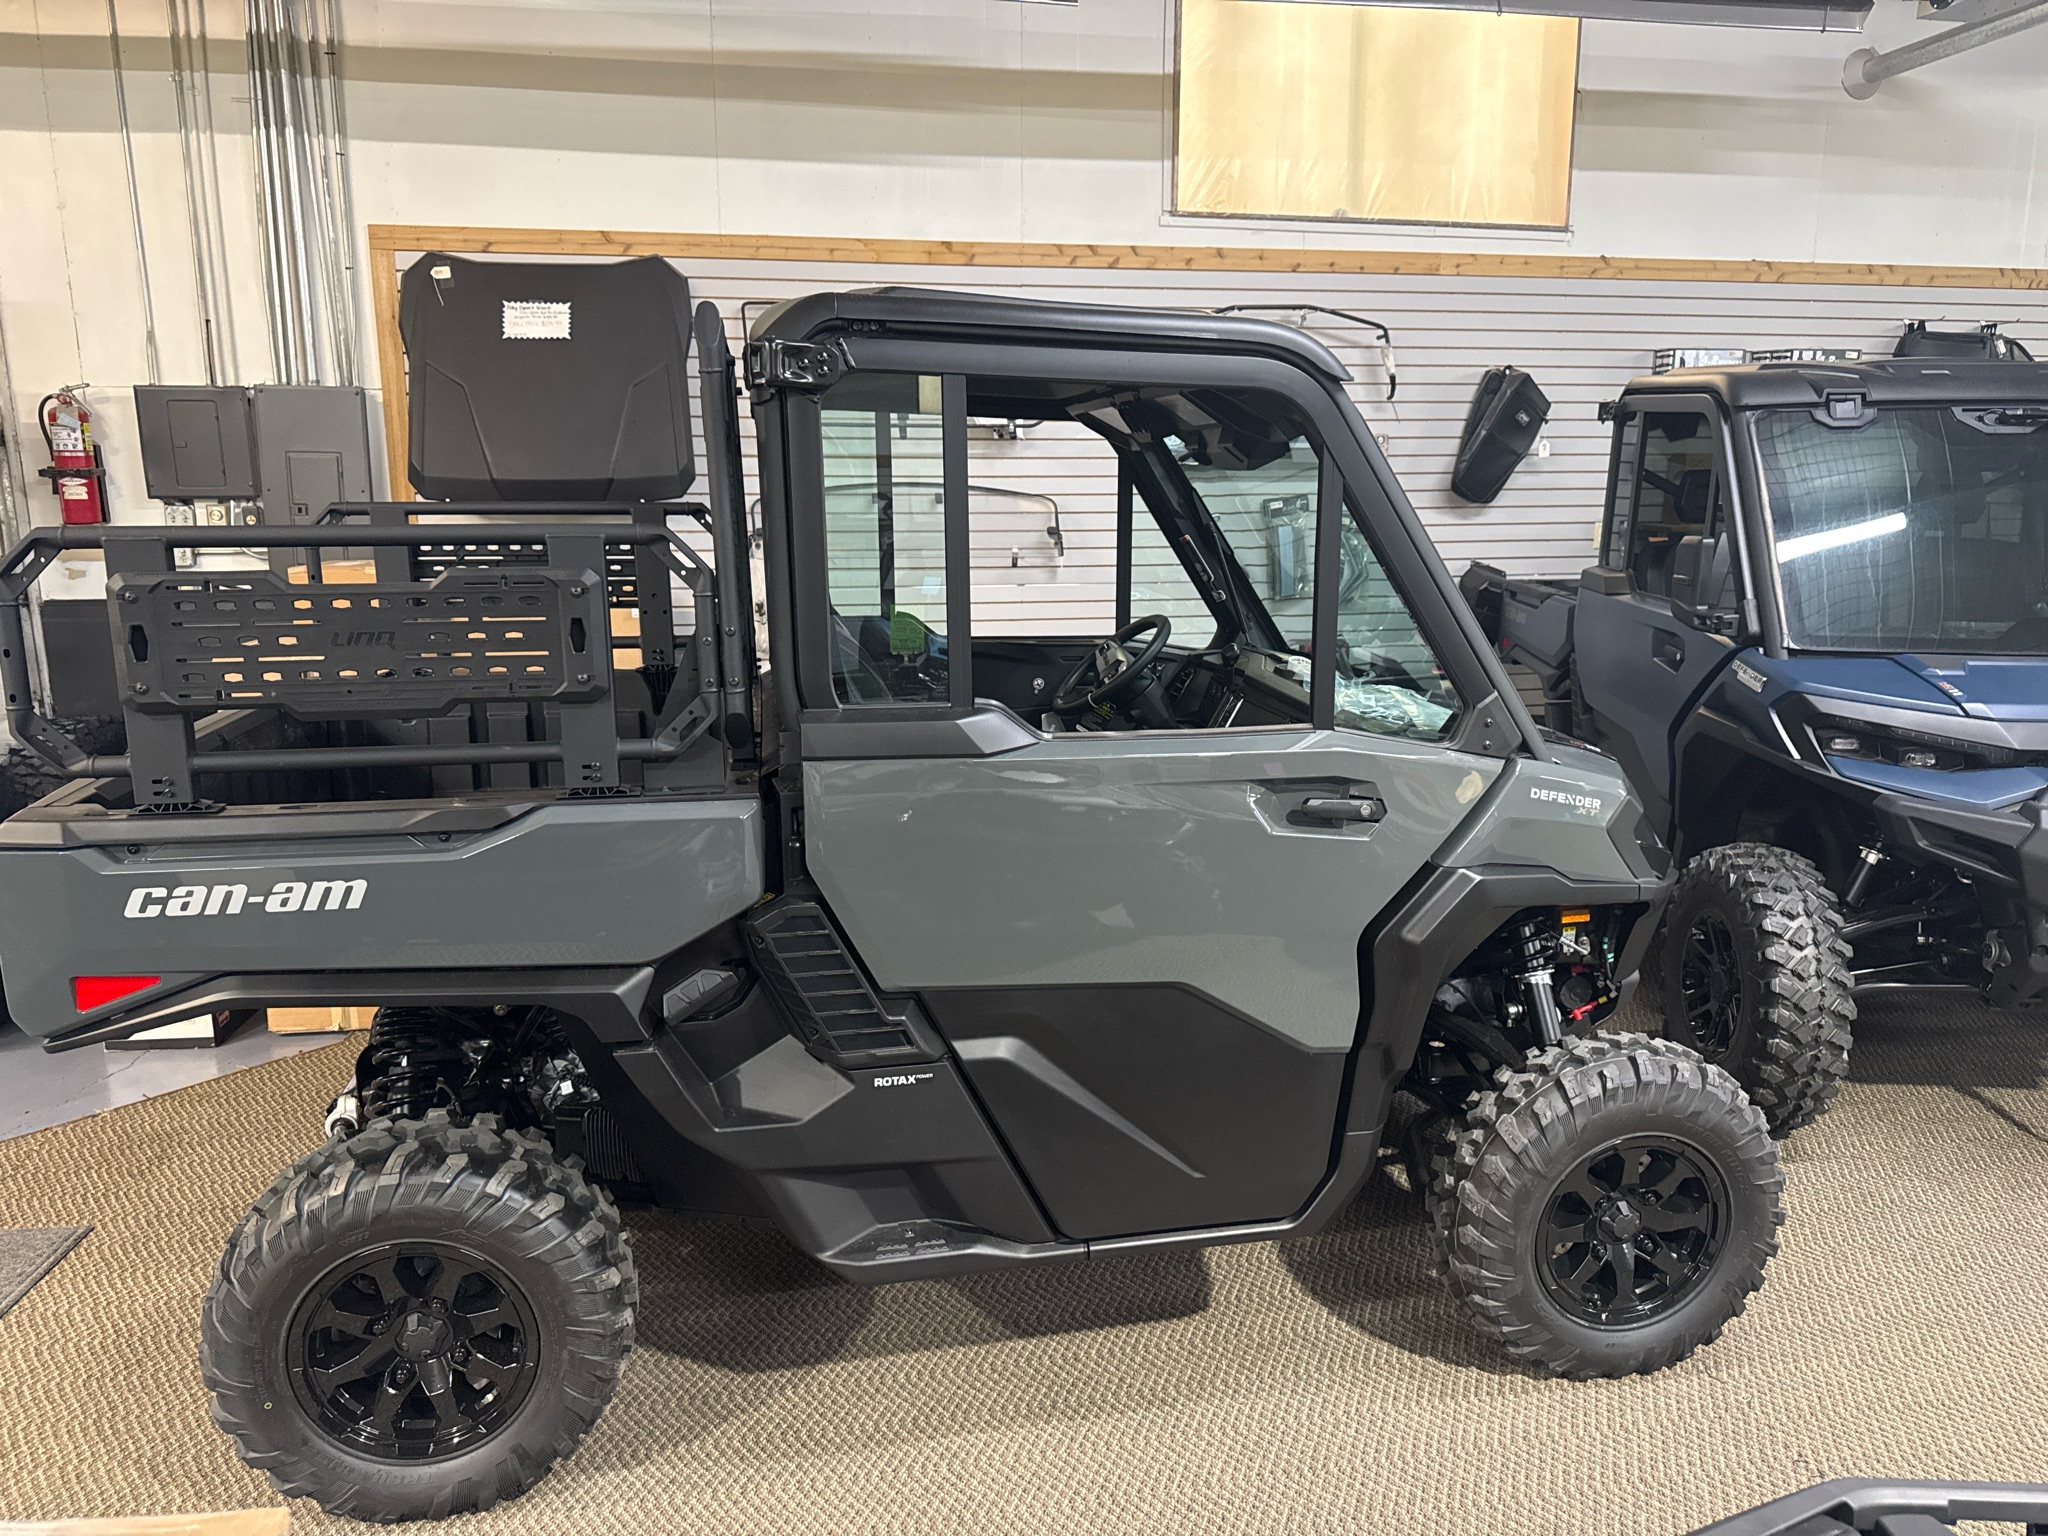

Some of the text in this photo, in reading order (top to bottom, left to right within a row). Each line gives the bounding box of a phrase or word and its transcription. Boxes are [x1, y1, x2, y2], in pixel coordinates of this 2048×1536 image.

[1733, 661, 1763, 684] DEFEDER
[1530, 787, 1601, 809] DEFENDER
[1574, 807, 1599, 816] XT
[124, 879, 368, 918] can-am
[874, 1075, 916, 1087] ROTAX
